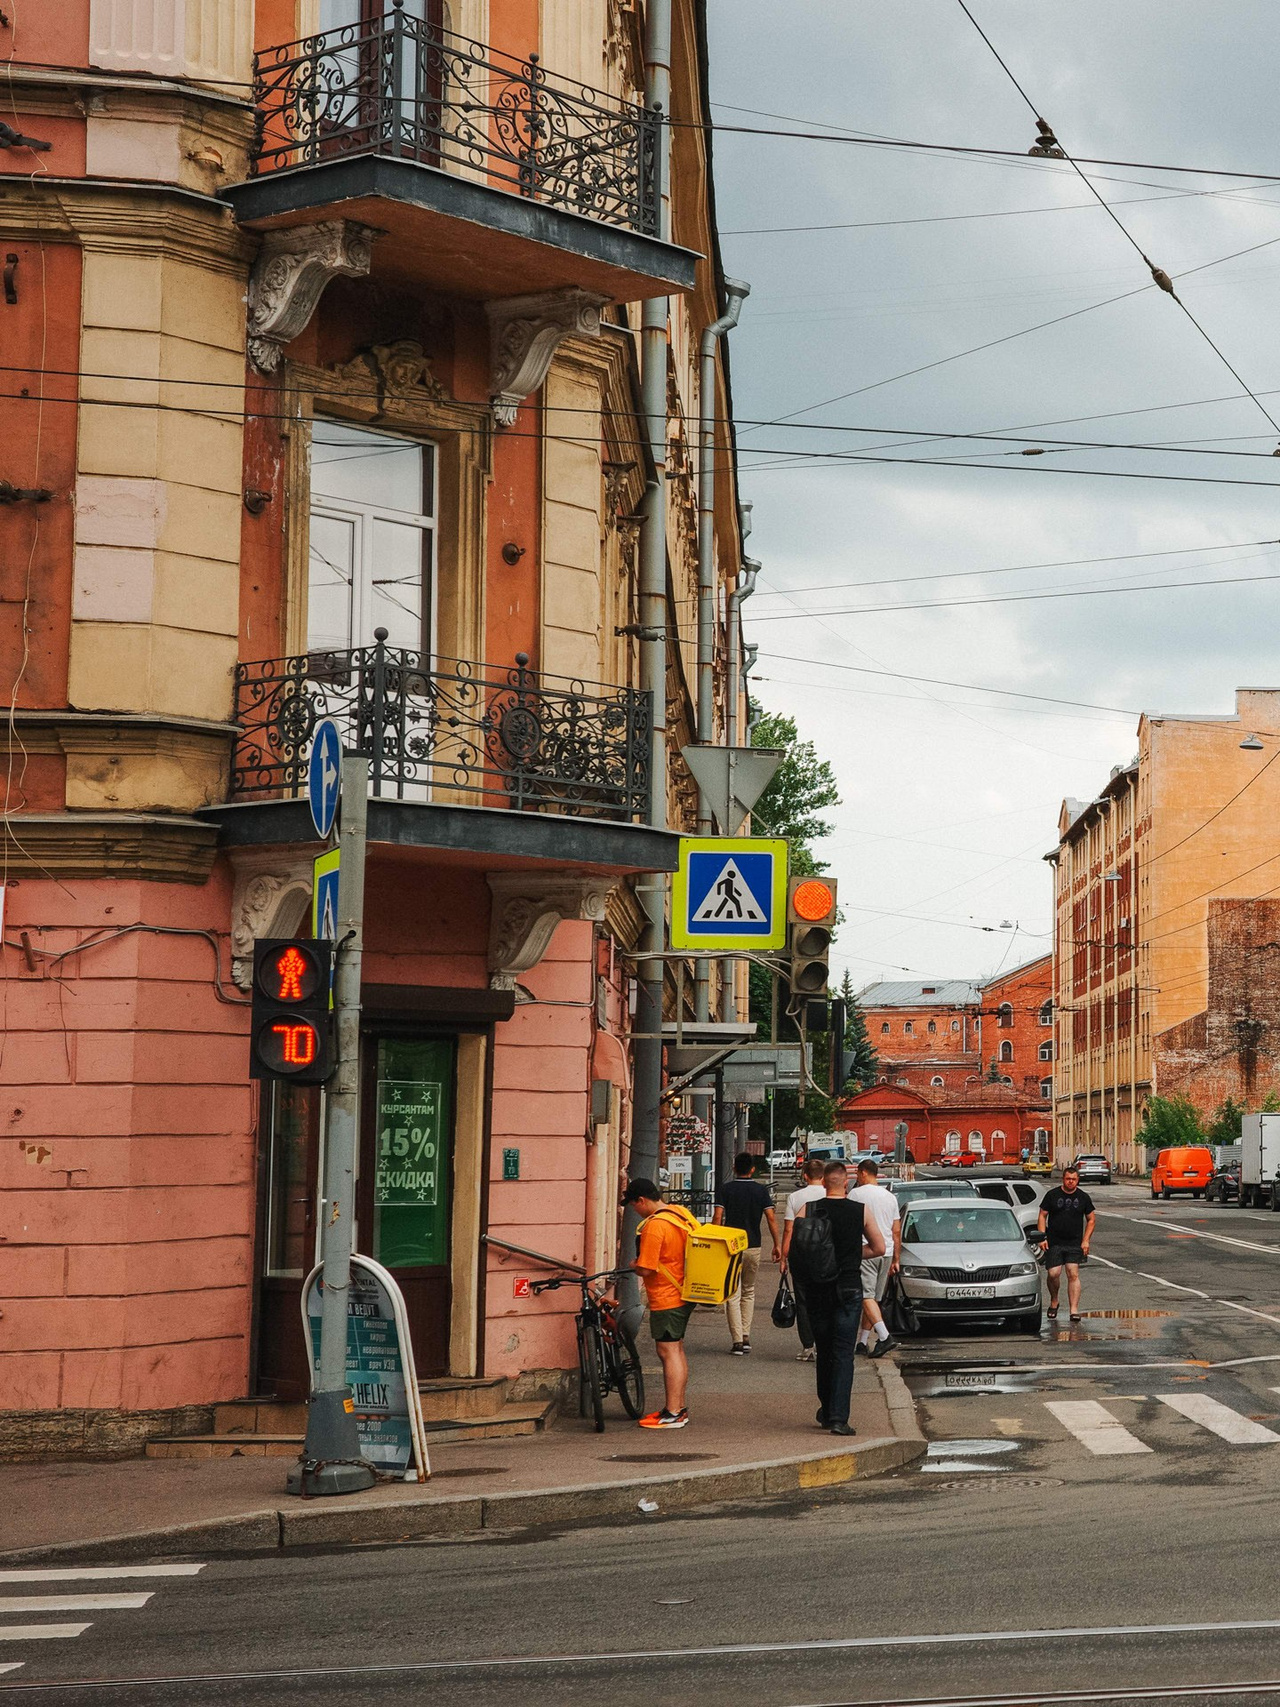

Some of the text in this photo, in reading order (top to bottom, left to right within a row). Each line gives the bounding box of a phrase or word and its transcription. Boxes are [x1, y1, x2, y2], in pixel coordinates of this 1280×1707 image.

[272, 1025, 314, 1063] 70
[381, 1104, 435, 1115] КУРСАНТАМ
[380, 1127, 436, 1161] 15%
[376, 1171, 435, 1189] СКИДКА
[355, 1304, 375, 1317] ВЕДУТ
[356, 1383, 388, 1405] HELIX
[366, 1421, 382, 1431] 2000
